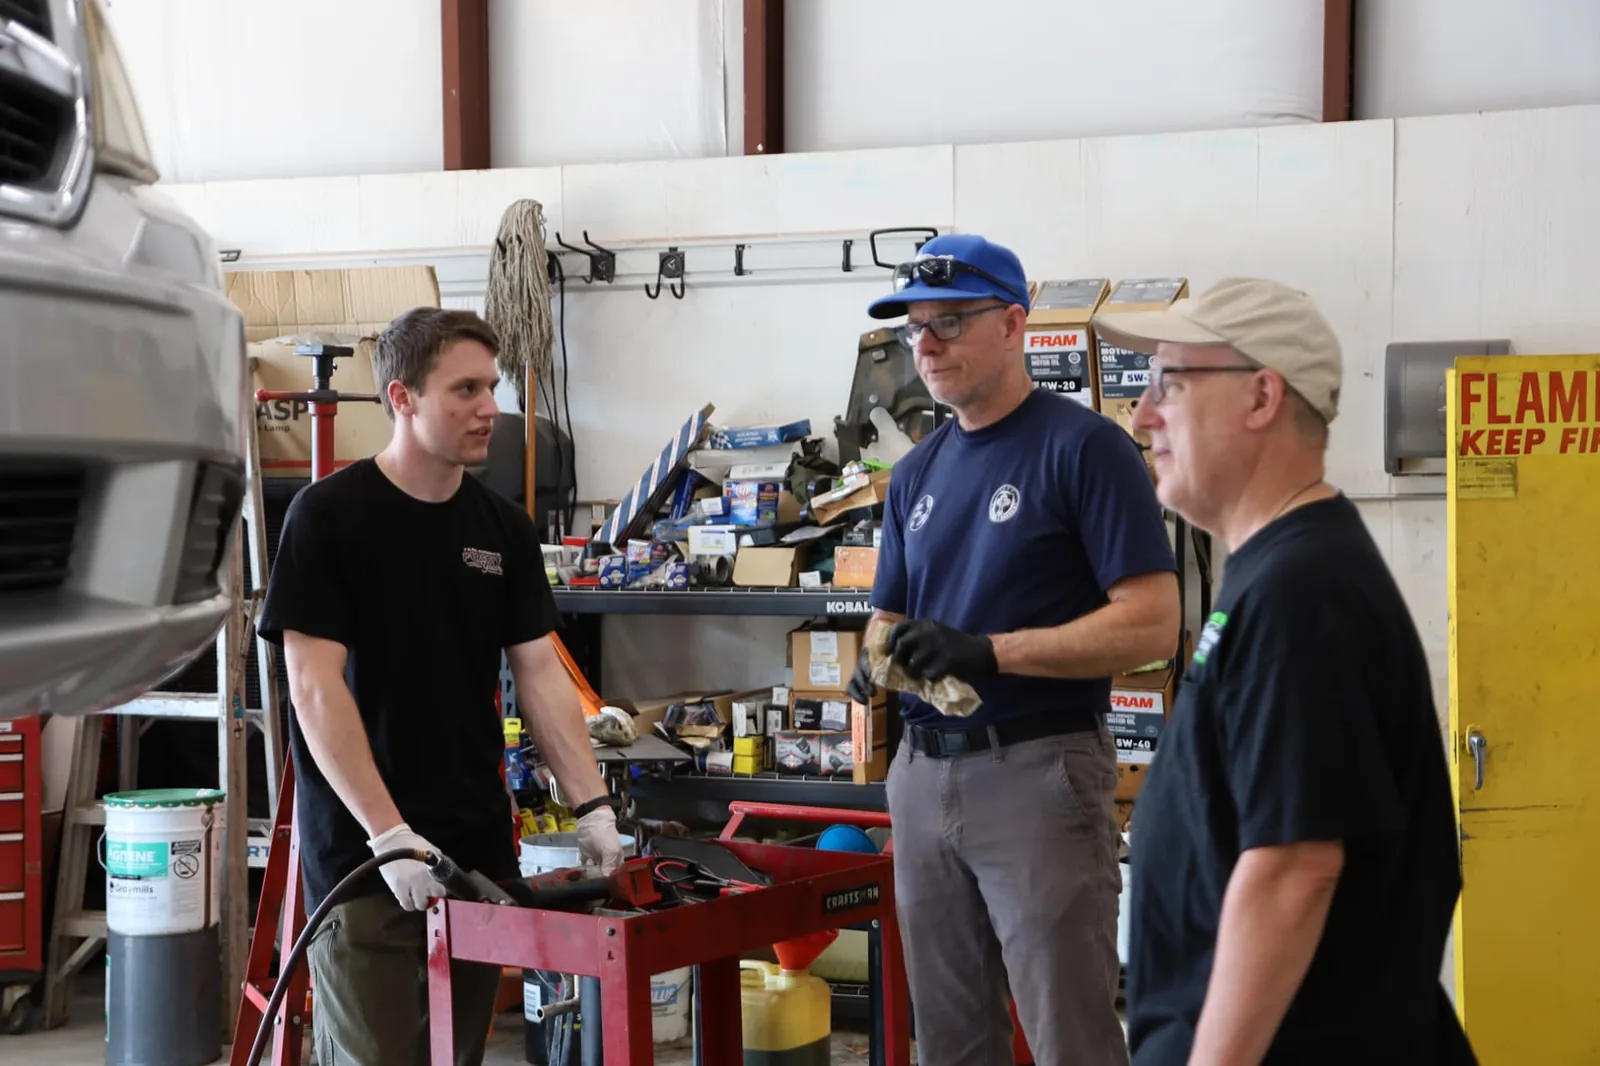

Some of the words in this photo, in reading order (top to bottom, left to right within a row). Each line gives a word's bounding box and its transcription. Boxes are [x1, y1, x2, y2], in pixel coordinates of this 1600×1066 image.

[1030, 335, 1077, 347] FRAM
[1103, 375, 1118, 383] SAE
[1127, 374, 1151, 383] 5W-
[1460, 429, 1546, 456] KEEP
[1116, 739, 1151, 748] 5W-40
